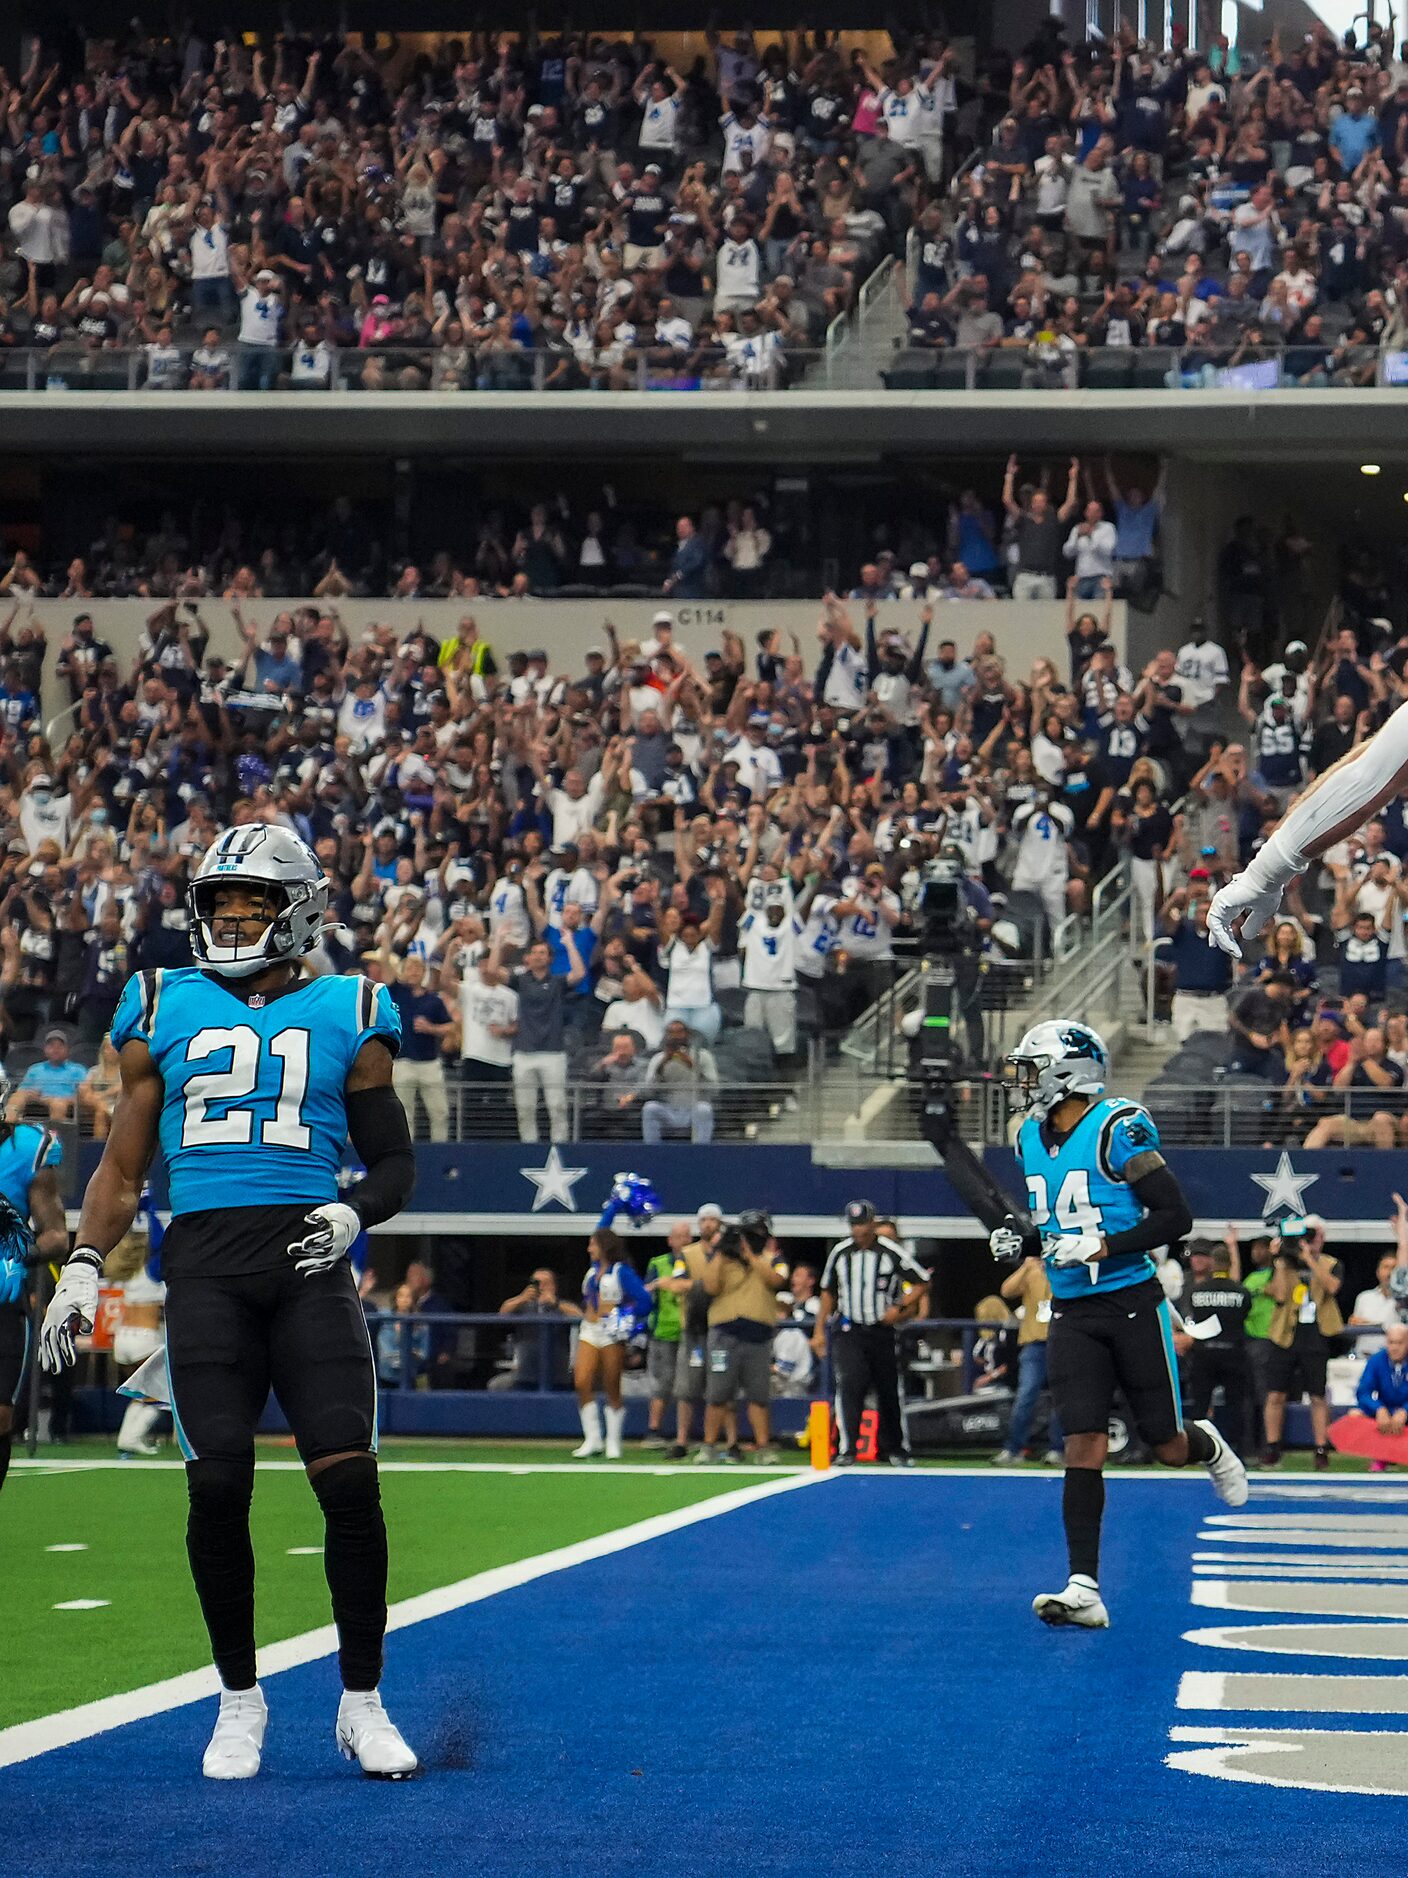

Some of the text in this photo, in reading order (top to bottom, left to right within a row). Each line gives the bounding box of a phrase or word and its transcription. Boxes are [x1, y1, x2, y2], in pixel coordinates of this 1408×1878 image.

[678, 608, 724, 625] C114
[1108, 728, 1137, 757] 13
[1261, 726, 1295, 756] 55
[1029, 813, 1045, 841] 4
[180, 1024, 313, 1151] 21
[1026, 1170, 1105, 1238] 24
[1192, 1291, 1244, 1307] SECURITY
